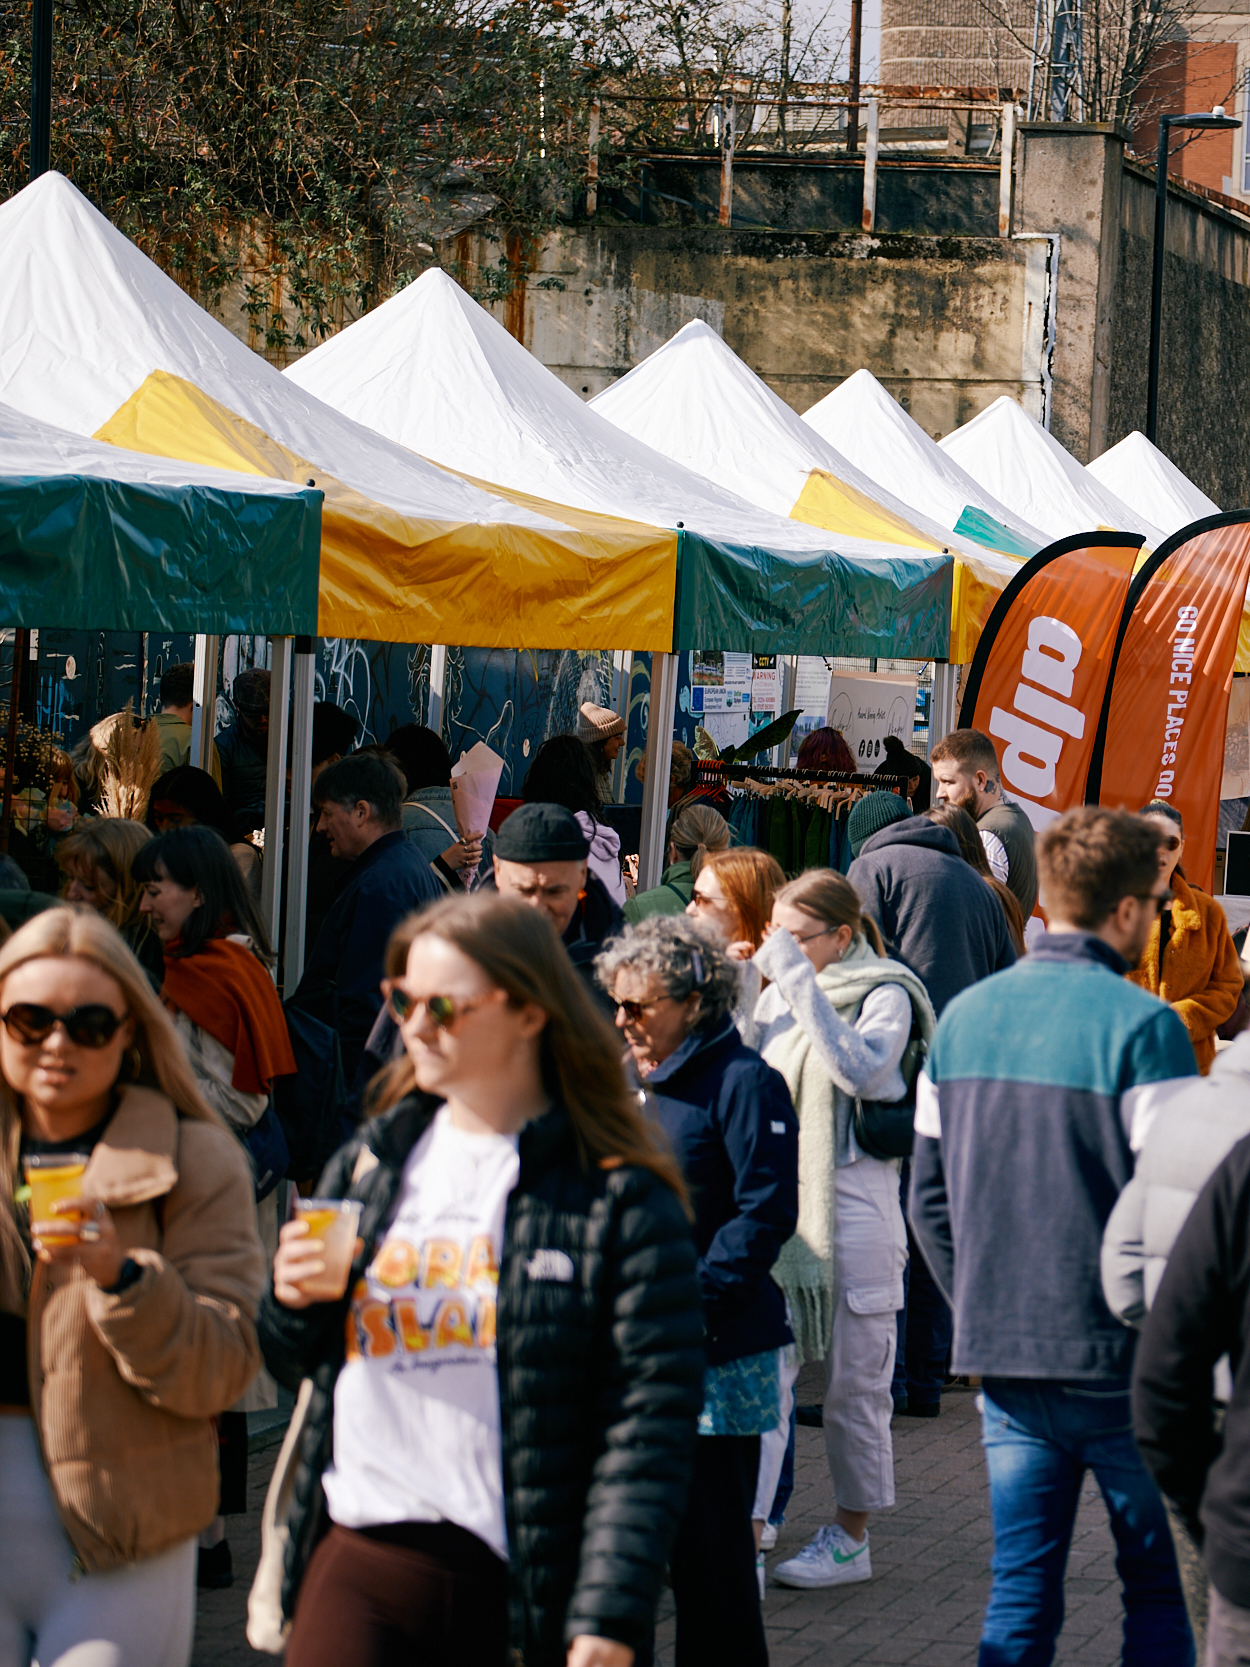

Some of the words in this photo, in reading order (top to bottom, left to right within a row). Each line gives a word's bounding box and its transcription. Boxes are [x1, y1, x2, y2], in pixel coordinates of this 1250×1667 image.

[1176, 605, 1199, 633] GO
[759, 656, 769, 666] CCTV
[1169, 637, 1196, 685] NICE
[1161, 689, 1189, 766] PLACES
[1154, 769, 1175, 797] DO
